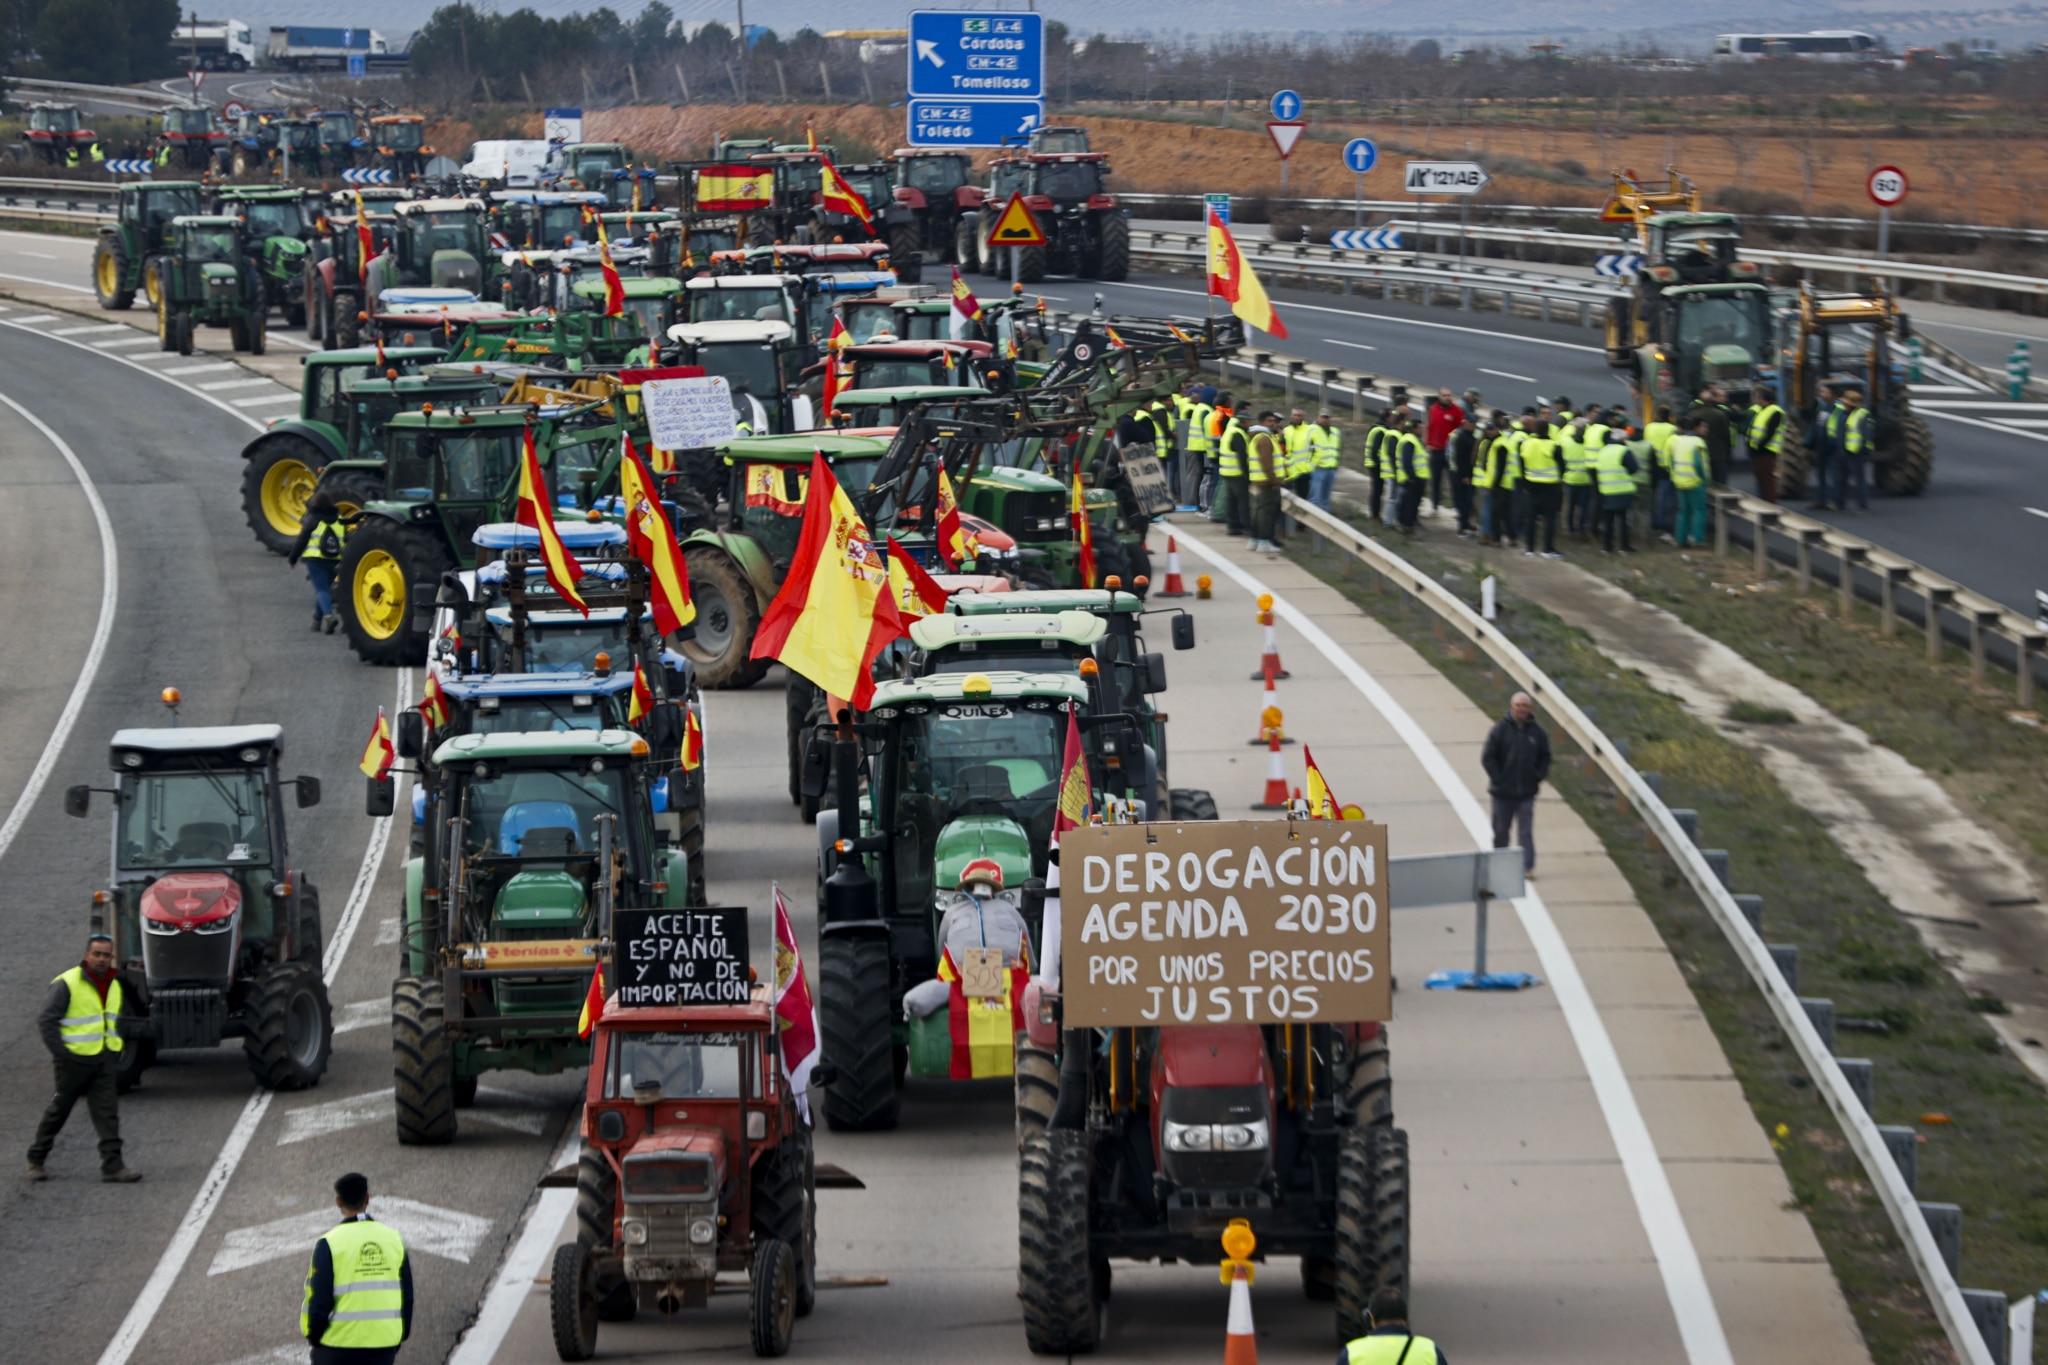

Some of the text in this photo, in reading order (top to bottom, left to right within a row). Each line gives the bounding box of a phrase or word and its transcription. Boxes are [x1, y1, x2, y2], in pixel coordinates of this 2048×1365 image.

[964, 20, 1022, 32] E-5 A-4
[960, 36, 1025, 51] Córdoba
[968, 56, 1018, 69] CM-42
[951, 75, 1032, 89] Tomelloso
[920, 108, 971, 120] CM-42
[916, 124, 974, 138] Toledo
[1432, 170, 1480, 186] 121AB
[674, 386, 700, 396] ESTAMOS
[1080, 892, 1377, 944] AGENDA 2030
[629, 936, 735, 960] ESPAÑOL
[636, 961, 741, 982] Y NO DE
[1088, 948, 1374, 986] POR UNOS PRECIOS
[966, 964, 1001, 992] SOS
[622, 980, 748, 1002] IMPORTACIÓN
[1140, 984, 1320, 1022] JUSTOS
